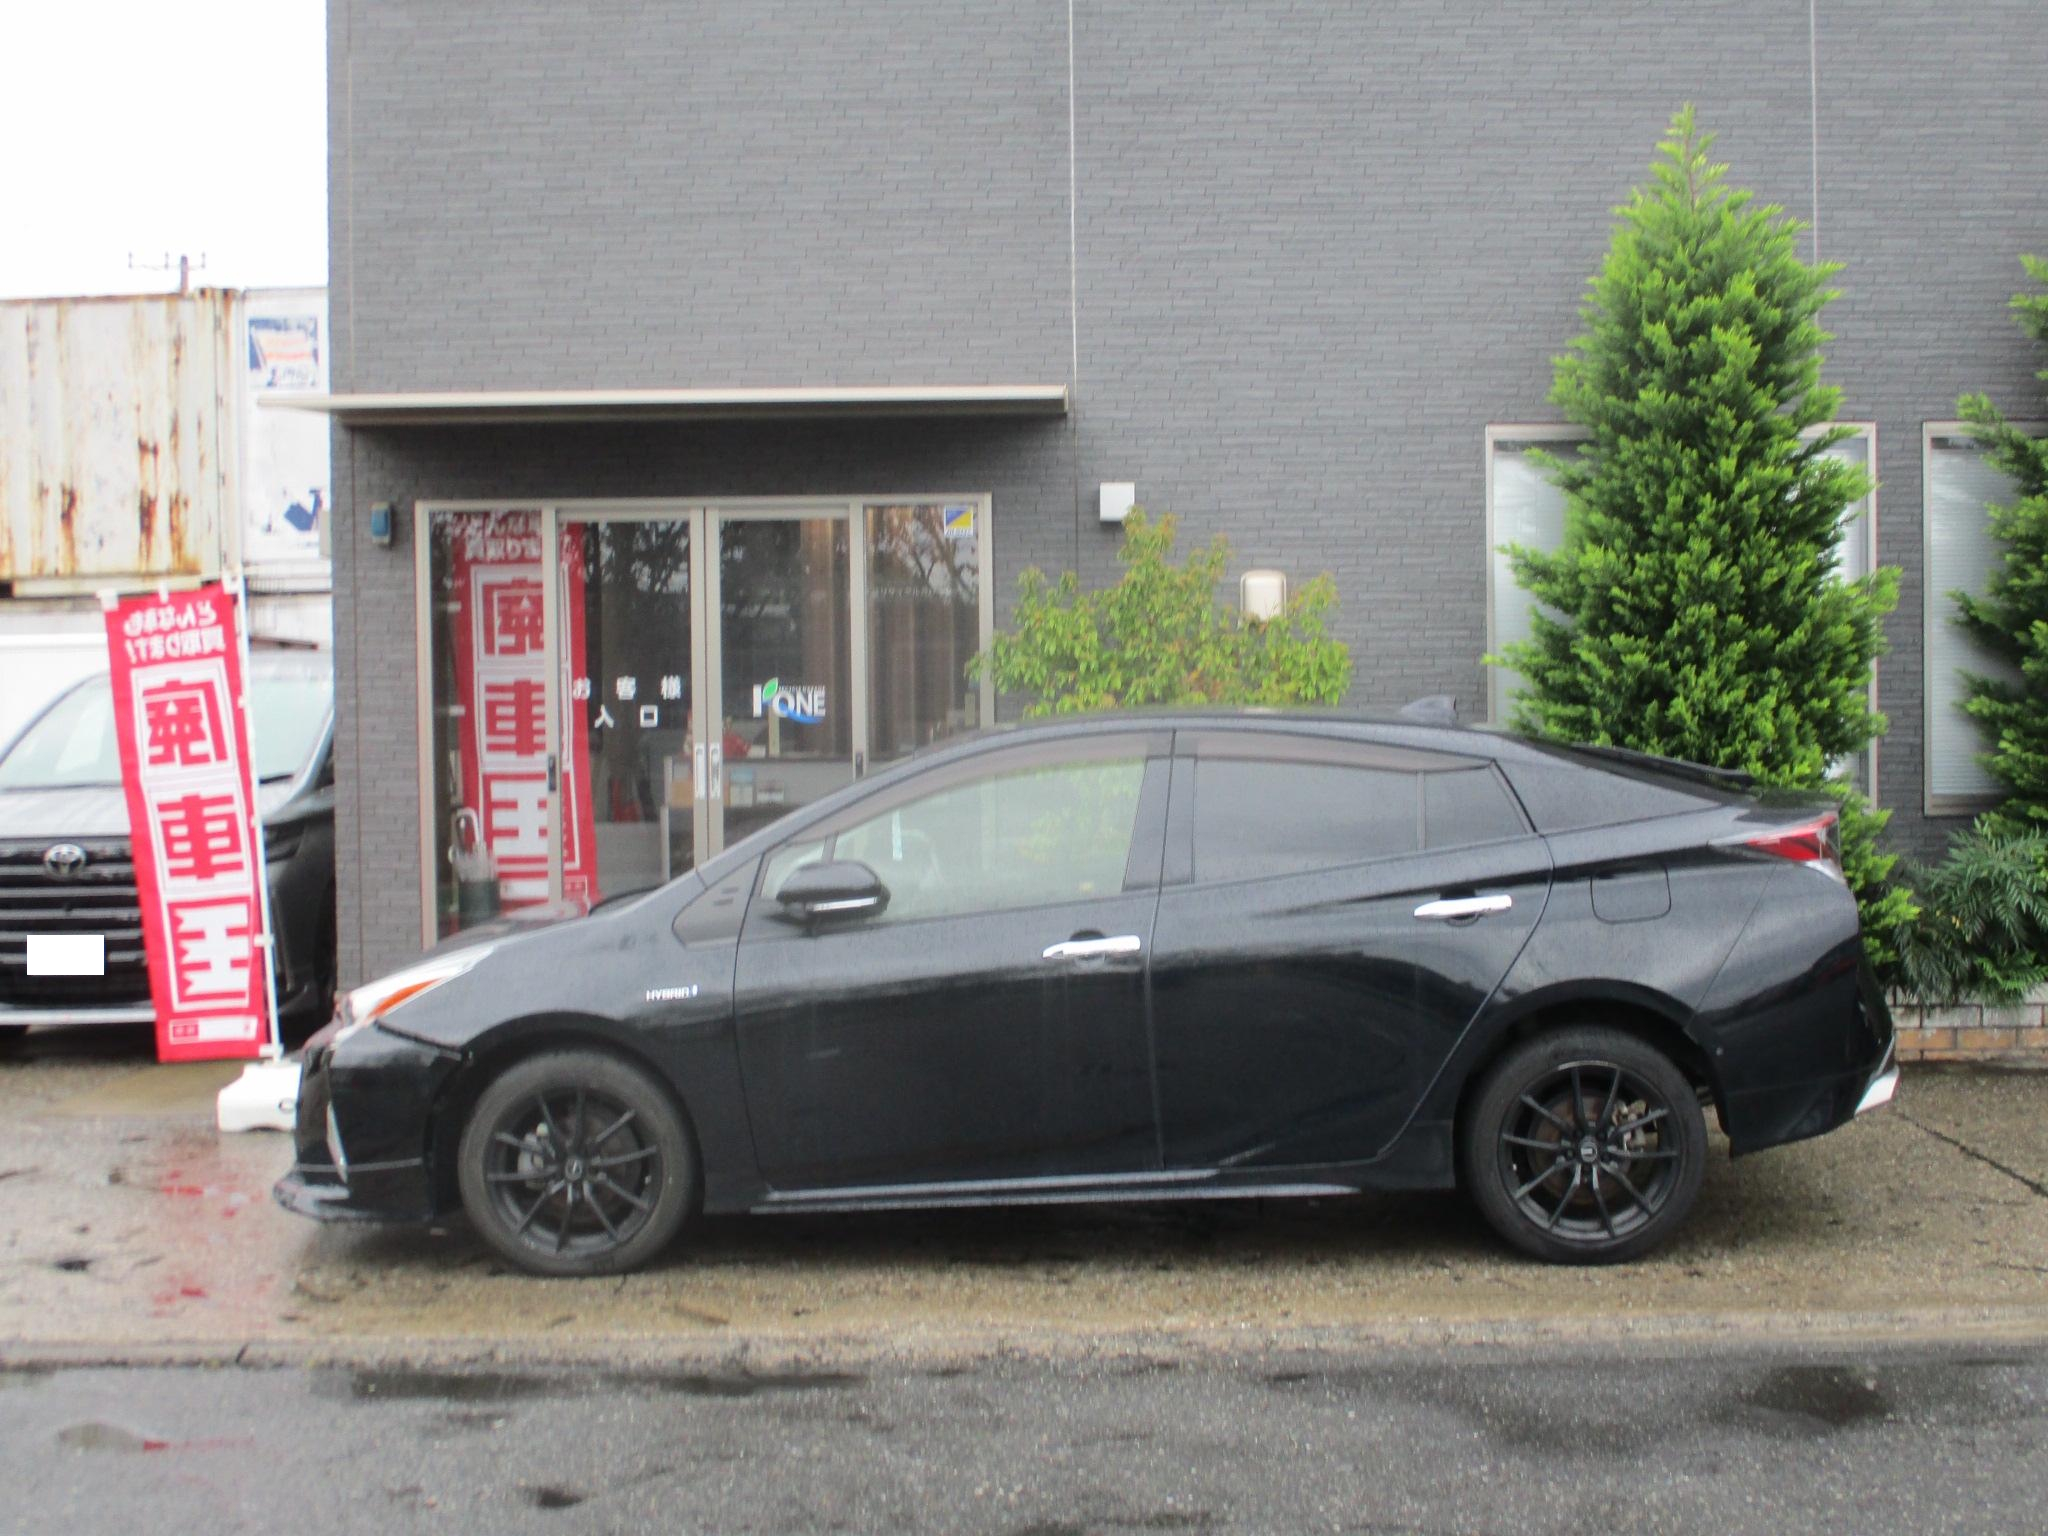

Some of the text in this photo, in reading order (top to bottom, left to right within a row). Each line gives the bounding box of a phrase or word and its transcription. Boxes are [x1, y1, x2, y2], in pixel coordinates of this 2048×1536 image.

[573, 675, 682, 701] お客様
[594, 704, 659, 729] 入口
